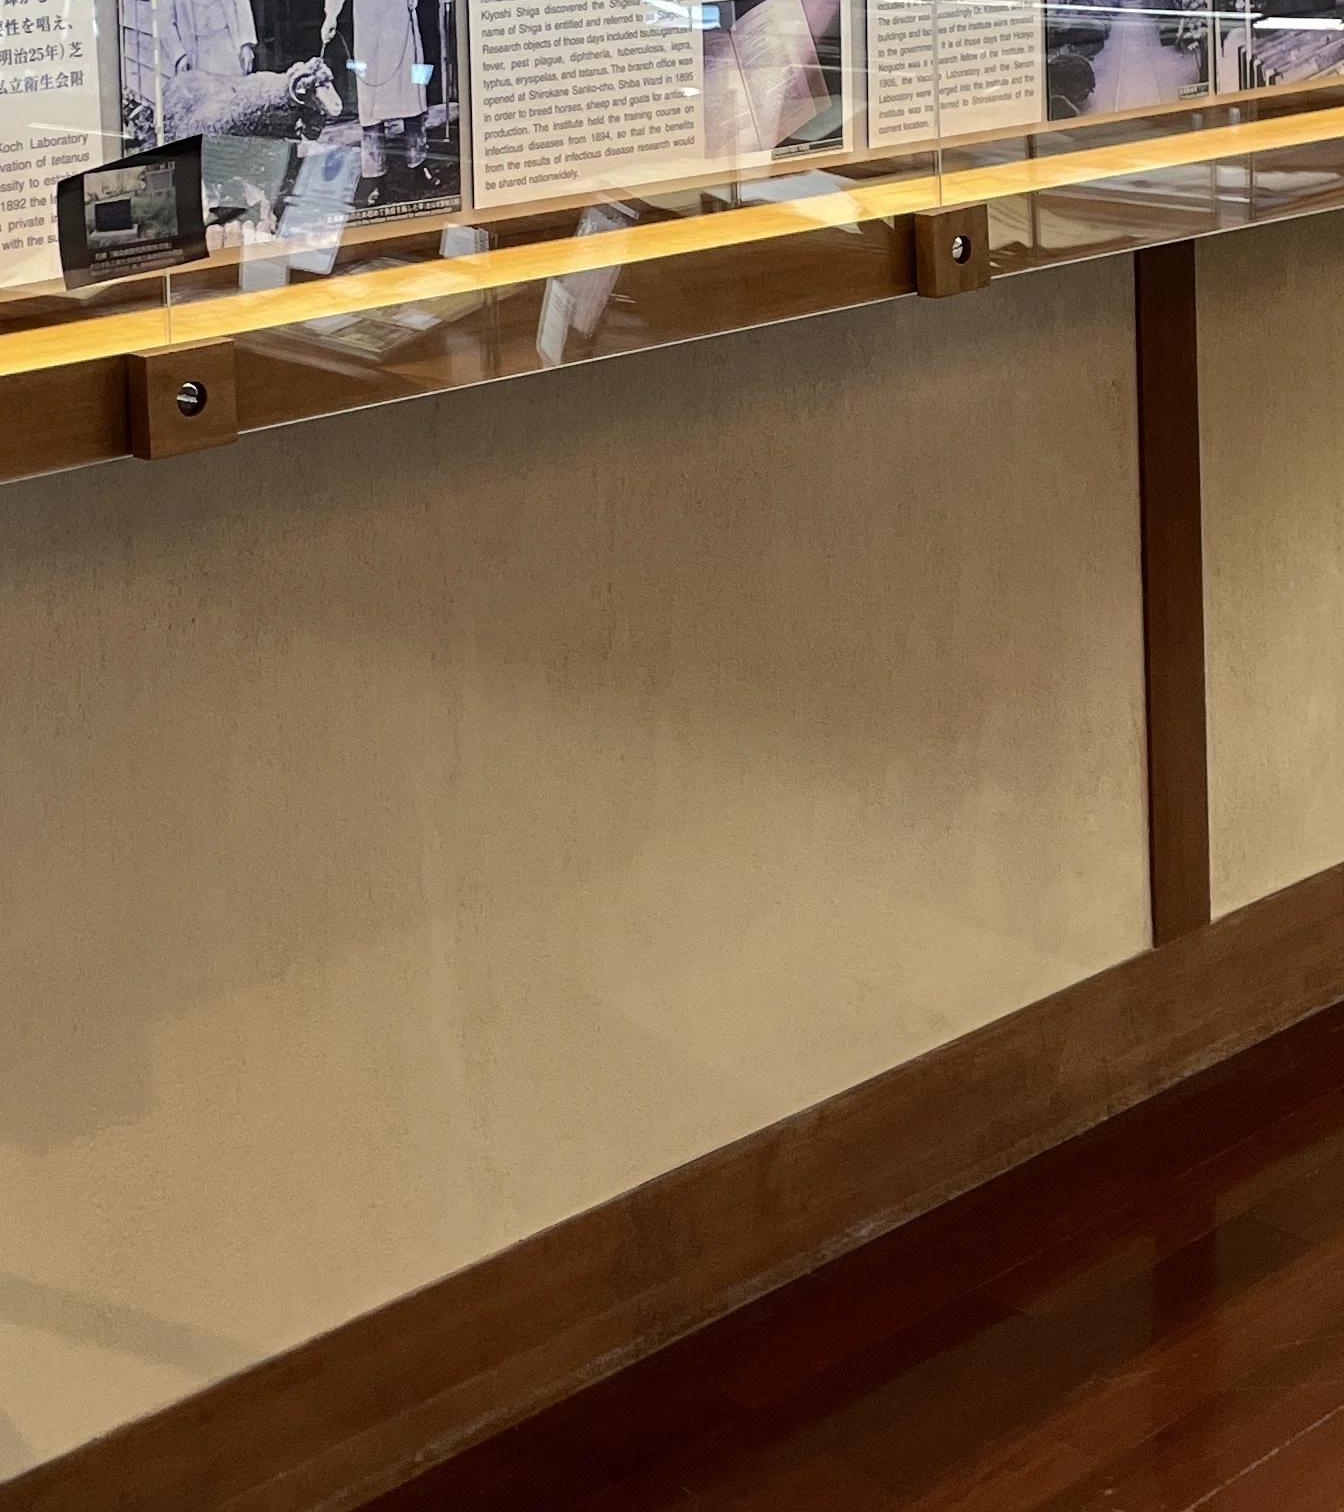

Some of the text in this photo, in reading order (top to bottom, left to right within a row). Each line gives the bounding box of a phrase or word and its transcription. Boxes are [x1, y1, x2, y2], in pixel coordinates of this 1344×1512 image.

[30, 131, 89, 150] Laboratory
[35, 155, 46, 168] of
[51, 152, 89, 165] tetanus
[28, 178, 39, 188] to
